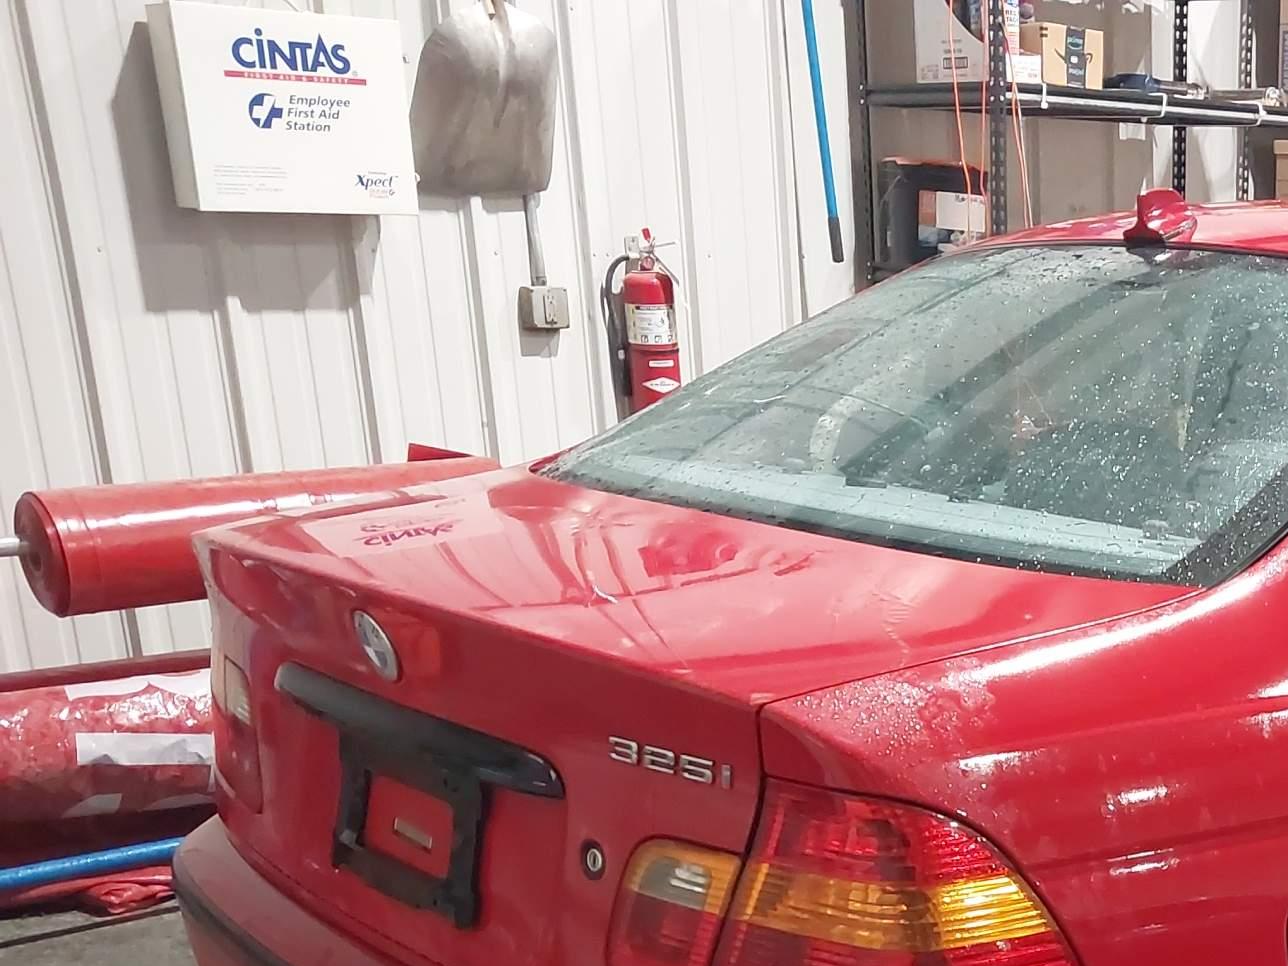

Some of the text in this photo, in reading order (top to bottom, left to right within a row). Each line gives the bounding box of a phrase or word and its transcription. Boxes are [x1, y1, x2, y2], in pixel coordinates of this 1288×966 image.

[289, 94, 351, 109] Employee
[287, 107, 340, 120] First Aid
[285, 120, 331, 132] Station
[355, 174, 393, 190] Xpect
[608, 736, 732, 790] 325i
